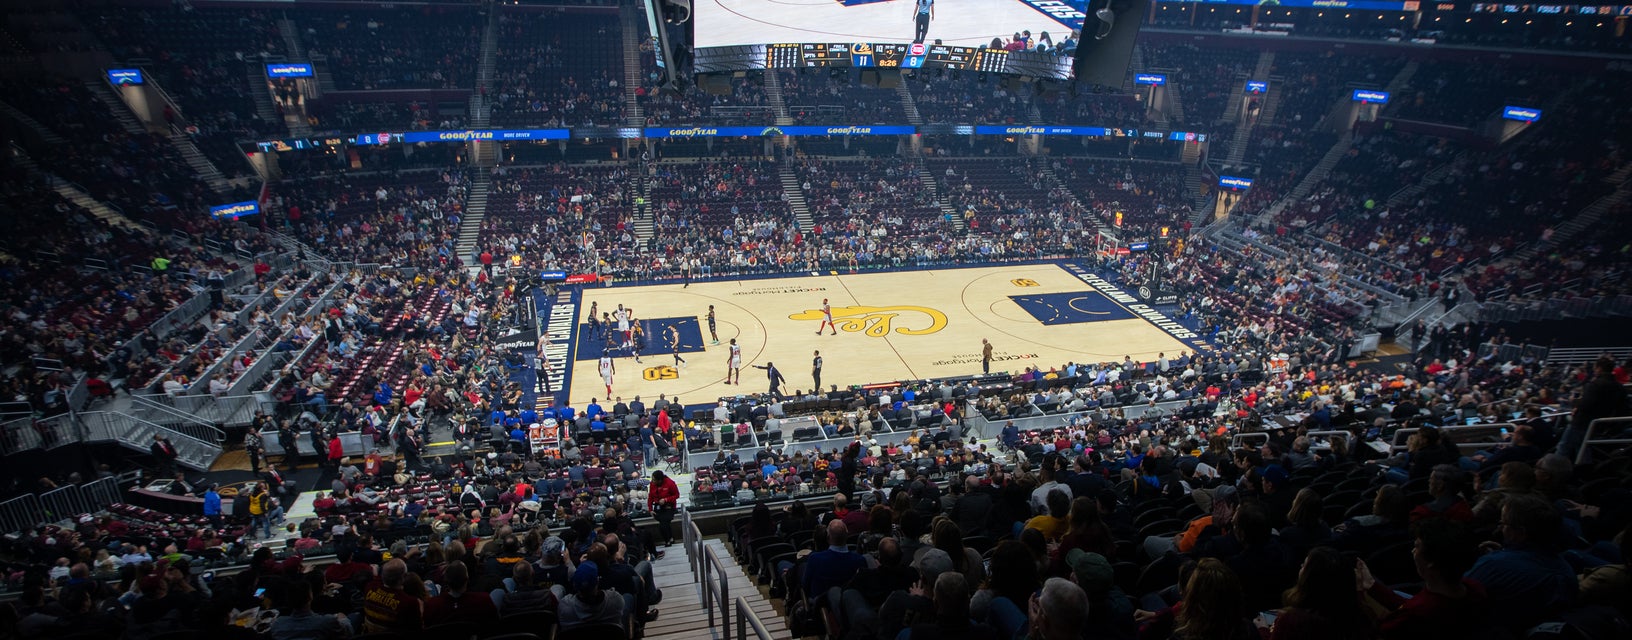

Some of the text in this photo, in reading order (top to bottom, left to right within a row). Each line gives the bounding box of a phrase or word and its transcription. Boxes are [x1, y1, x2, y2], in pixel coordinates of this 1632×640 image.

[859, 56, 868, 66] 11
[879, 59, 897, 67] 8:26
[909, 56, 917, 66] 8
[669, 127, 718, 137] GOODYEAR
[827, 126, 872, 135] GOODYEAR
[1006, 125, 1046, 135] GOODYEAR
[364, 135, 372, 144] 8
[439, 130, 494, 141] GOODYEAR
[295, 140, 303, 149] 11
[1078, 273, 1198, 339] CLEVELAND CAVALIERS
[503, 340, 535, 350] OODYEAR
[990, 353, 1039, 363] ROCKET
